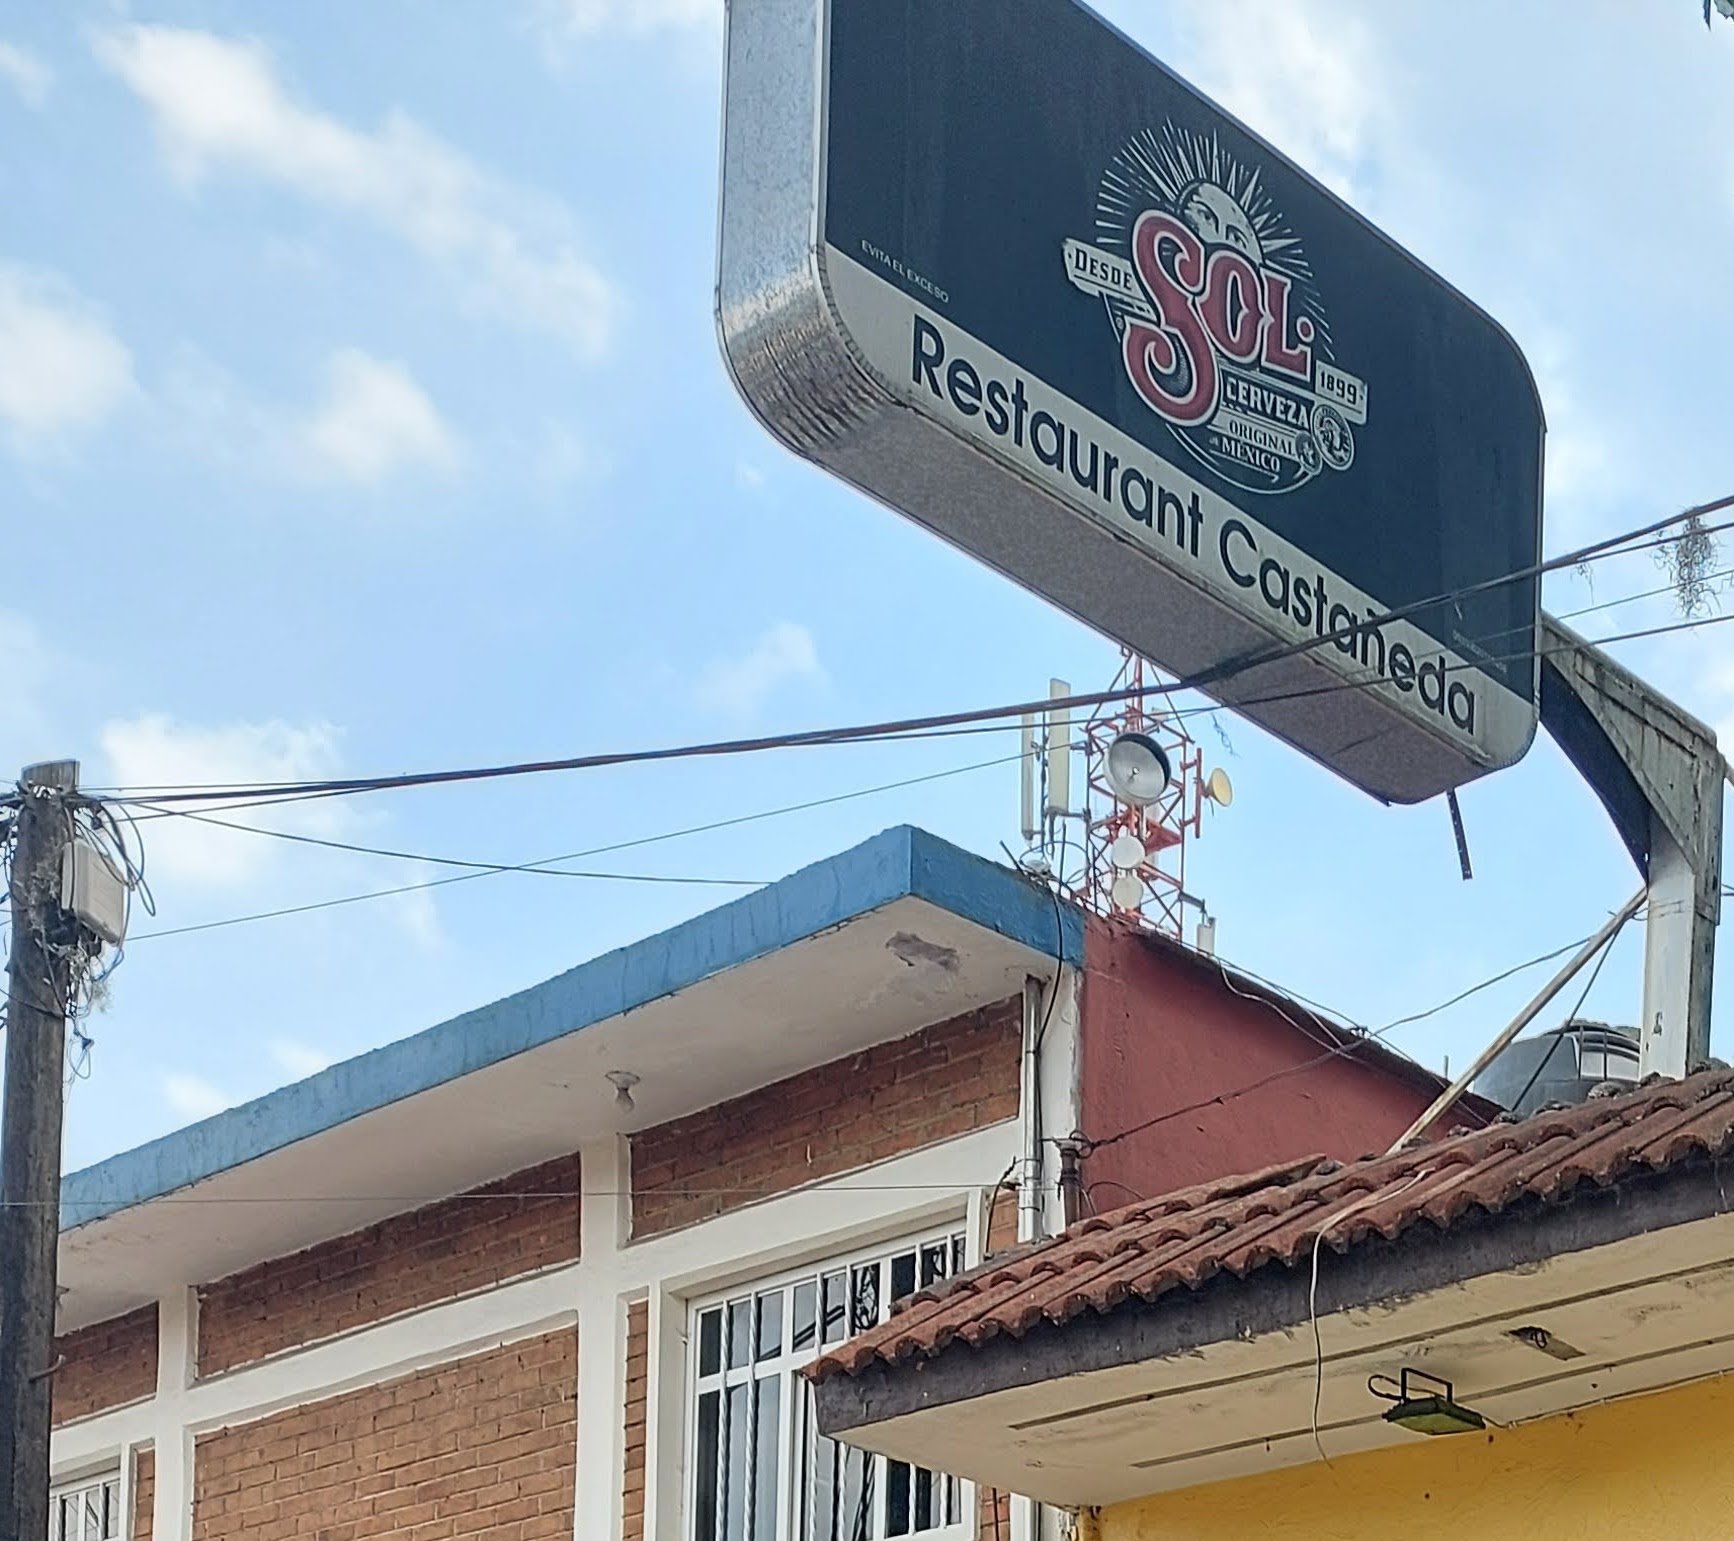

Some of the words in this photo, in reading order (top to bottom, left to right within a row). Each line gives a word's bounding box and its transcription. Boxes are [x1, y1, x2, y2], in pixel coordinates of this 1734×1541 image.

[861, 239, 892, 267] EVITA
[892, 259, 905, 276] EL
[906, 268, 950, 304] EXCESO
[1074, 248, 1134, 291] DESDE
[1226, 376, 1310, 429] CERVEZA
[1320, 370, 1358, 406] 1899
[1229, 419, 1296, 456] ORIGINAL
[912, 313, 1204, 559] Restaurant
[1219, 518, 1475, 736] Castañeda
